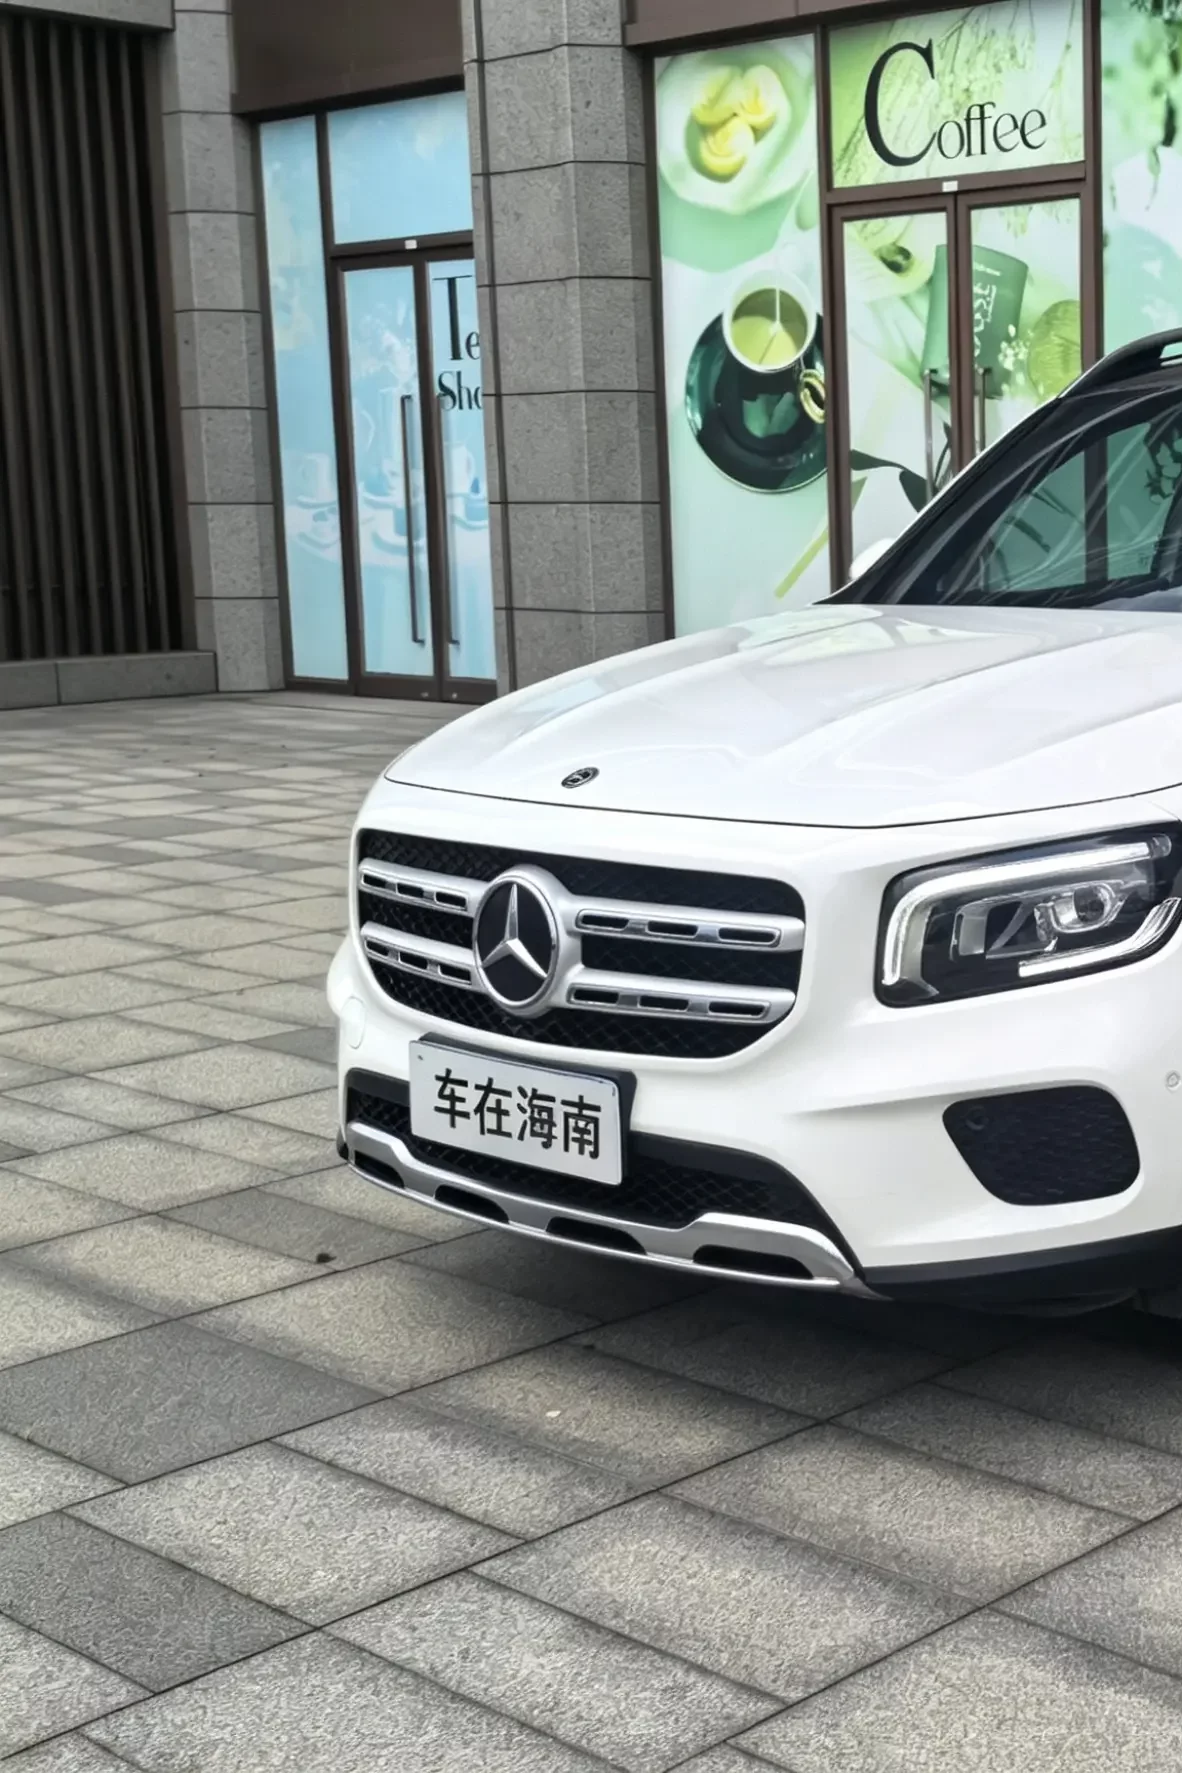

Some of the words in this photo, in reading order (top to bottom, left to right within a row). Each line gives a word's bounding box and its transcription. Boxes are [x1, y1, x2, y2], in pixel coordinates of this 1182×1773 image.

[864, 38, 1047, 167] Coffee
[433, 1068, 602, 1160] 车在海南
